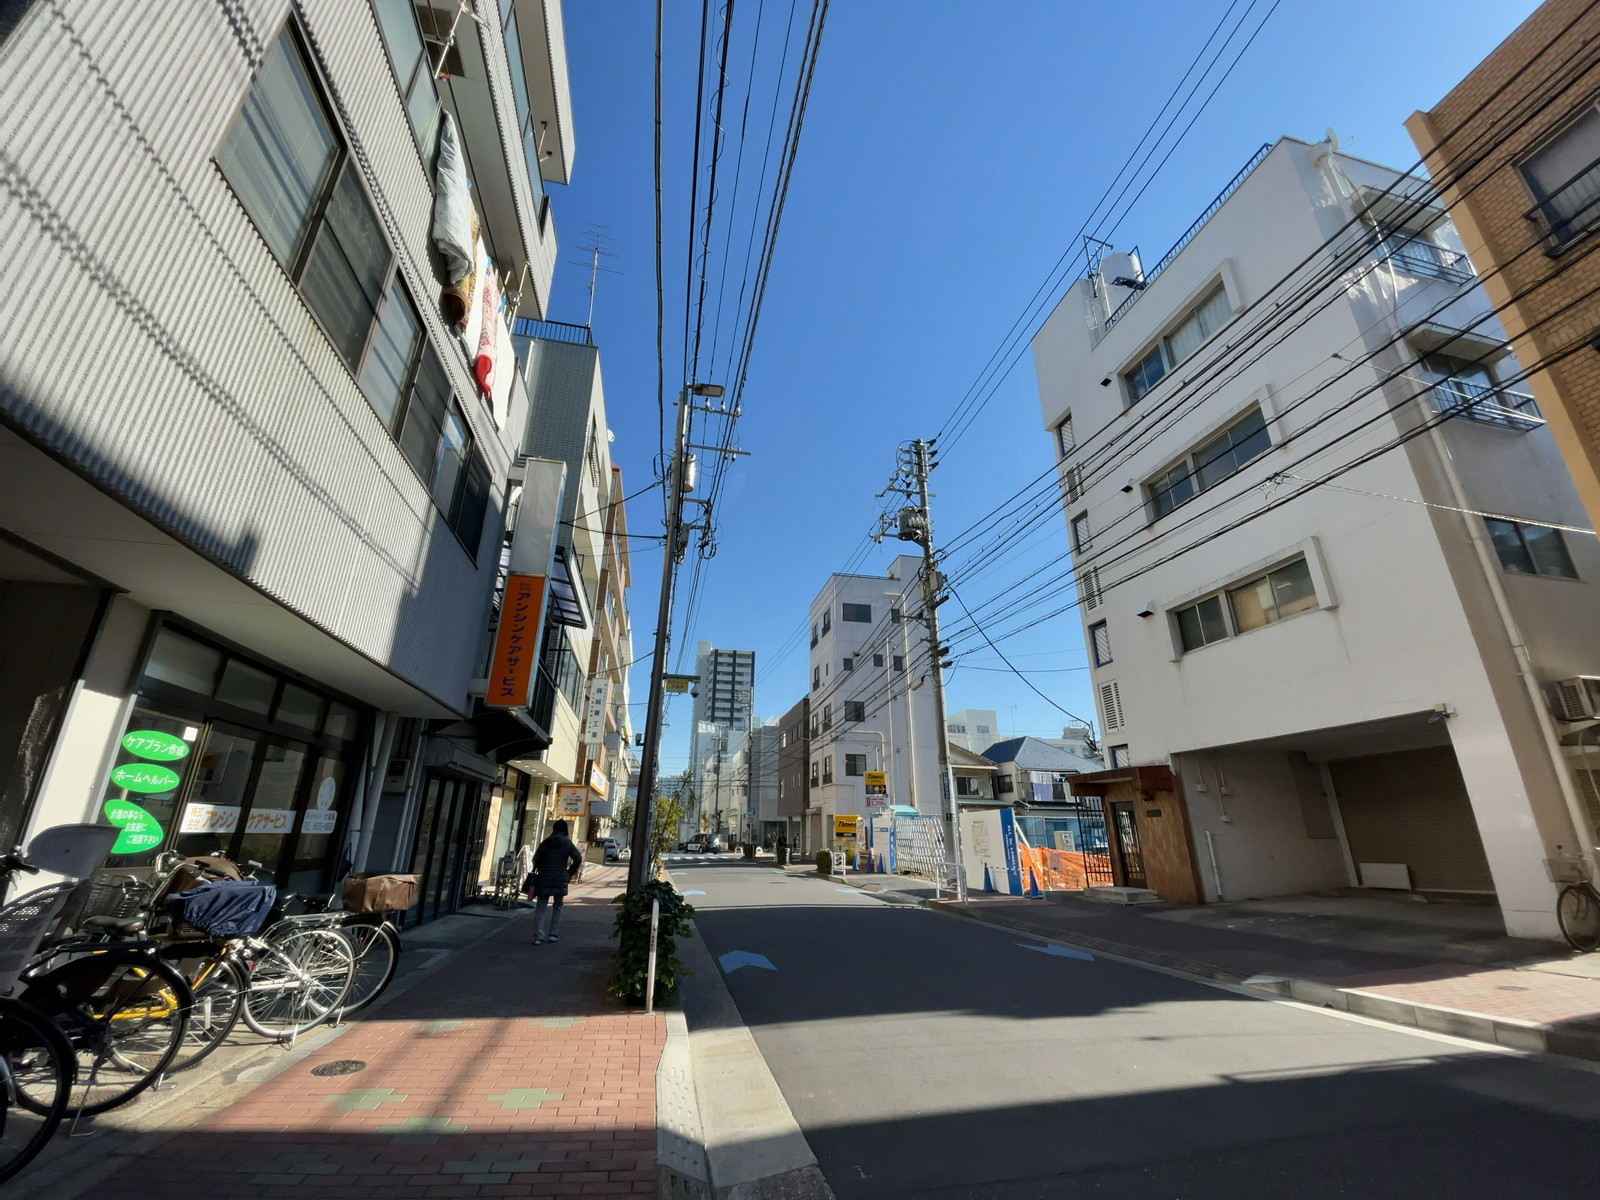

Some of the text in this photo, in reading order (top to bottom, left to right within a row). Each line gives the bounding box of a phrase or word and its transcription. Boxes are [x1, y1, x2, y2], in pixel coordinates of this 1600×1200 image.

[500, 592, 531, 697] アンシンケアサービス
[127, 736, 185, 757] ケアプラン作成
[115, 769, 176, 785] ホームヘルパー
[202, 810, 288, 830] アンシン ケアサービス
